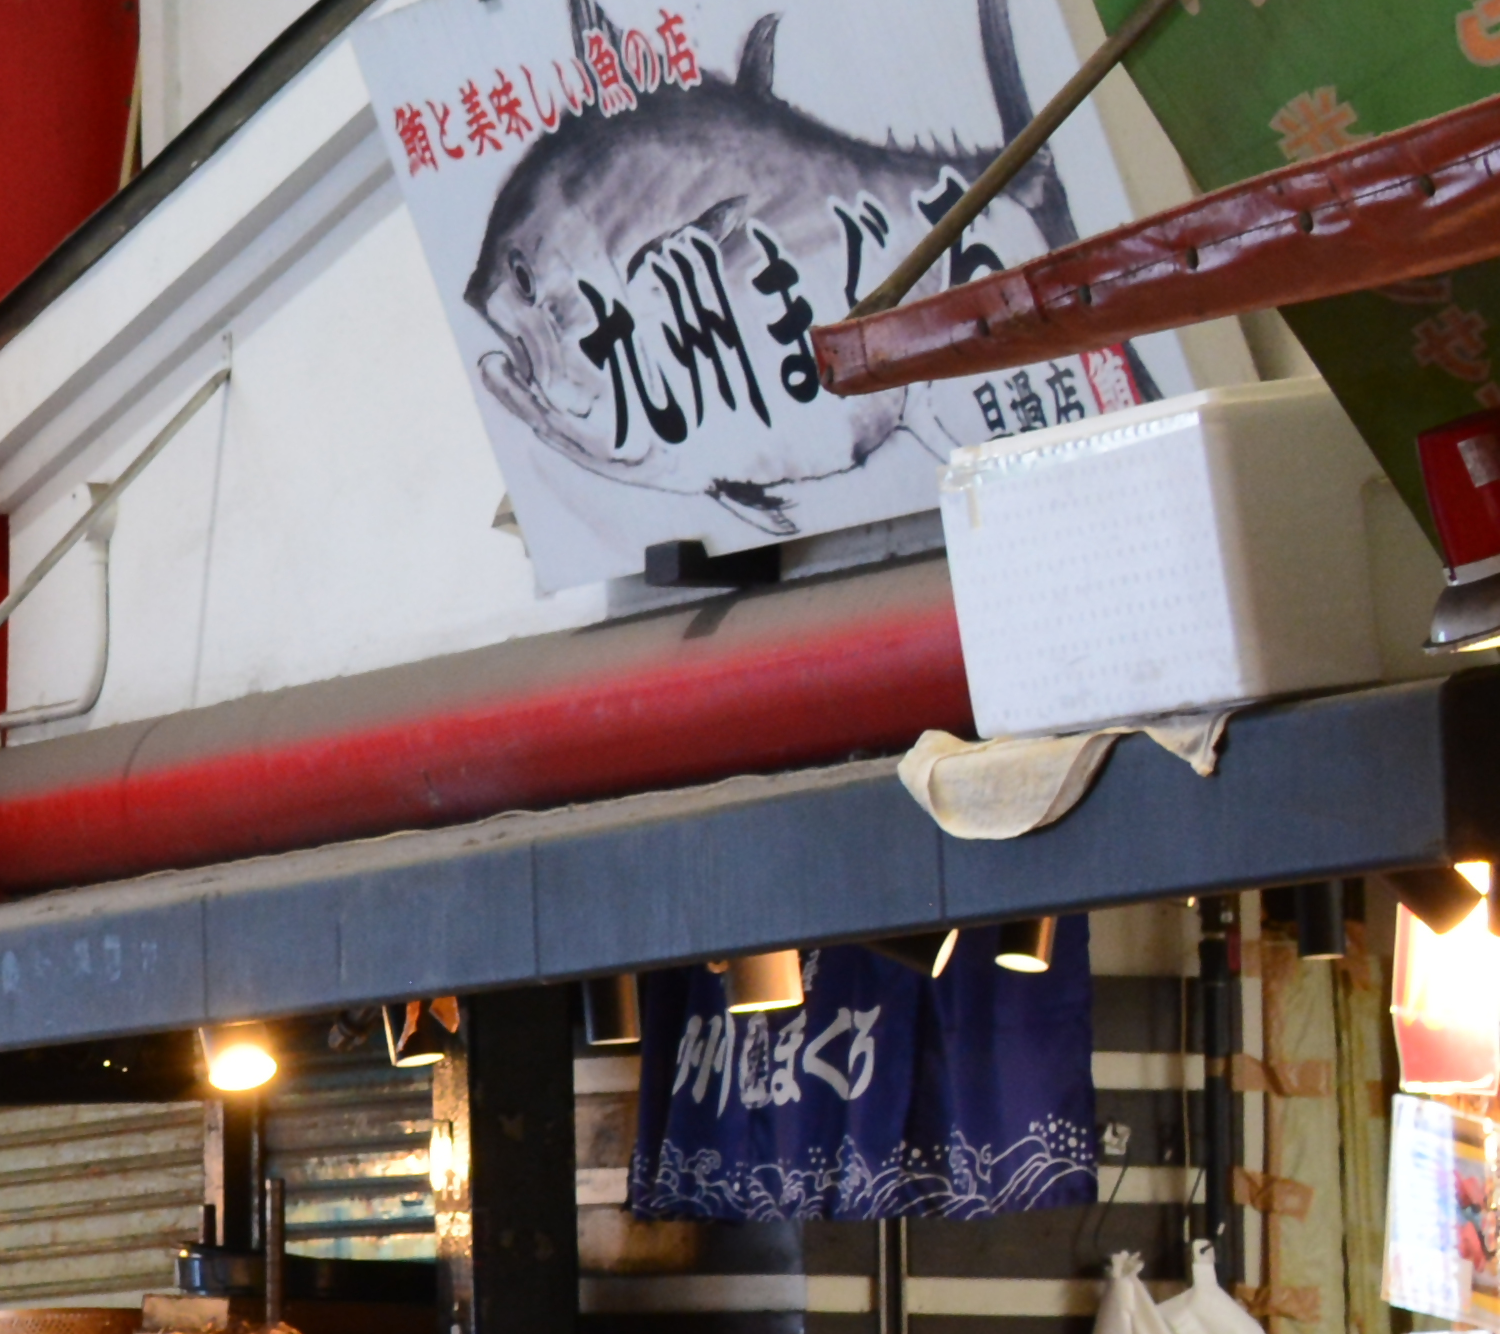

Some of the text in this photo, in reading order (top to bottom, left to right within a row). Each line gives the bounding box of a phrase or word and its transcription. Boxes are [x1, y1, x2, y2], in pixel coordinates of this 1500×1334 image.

[393, 7, 702, 177] 鮪と美味しい魚の店
